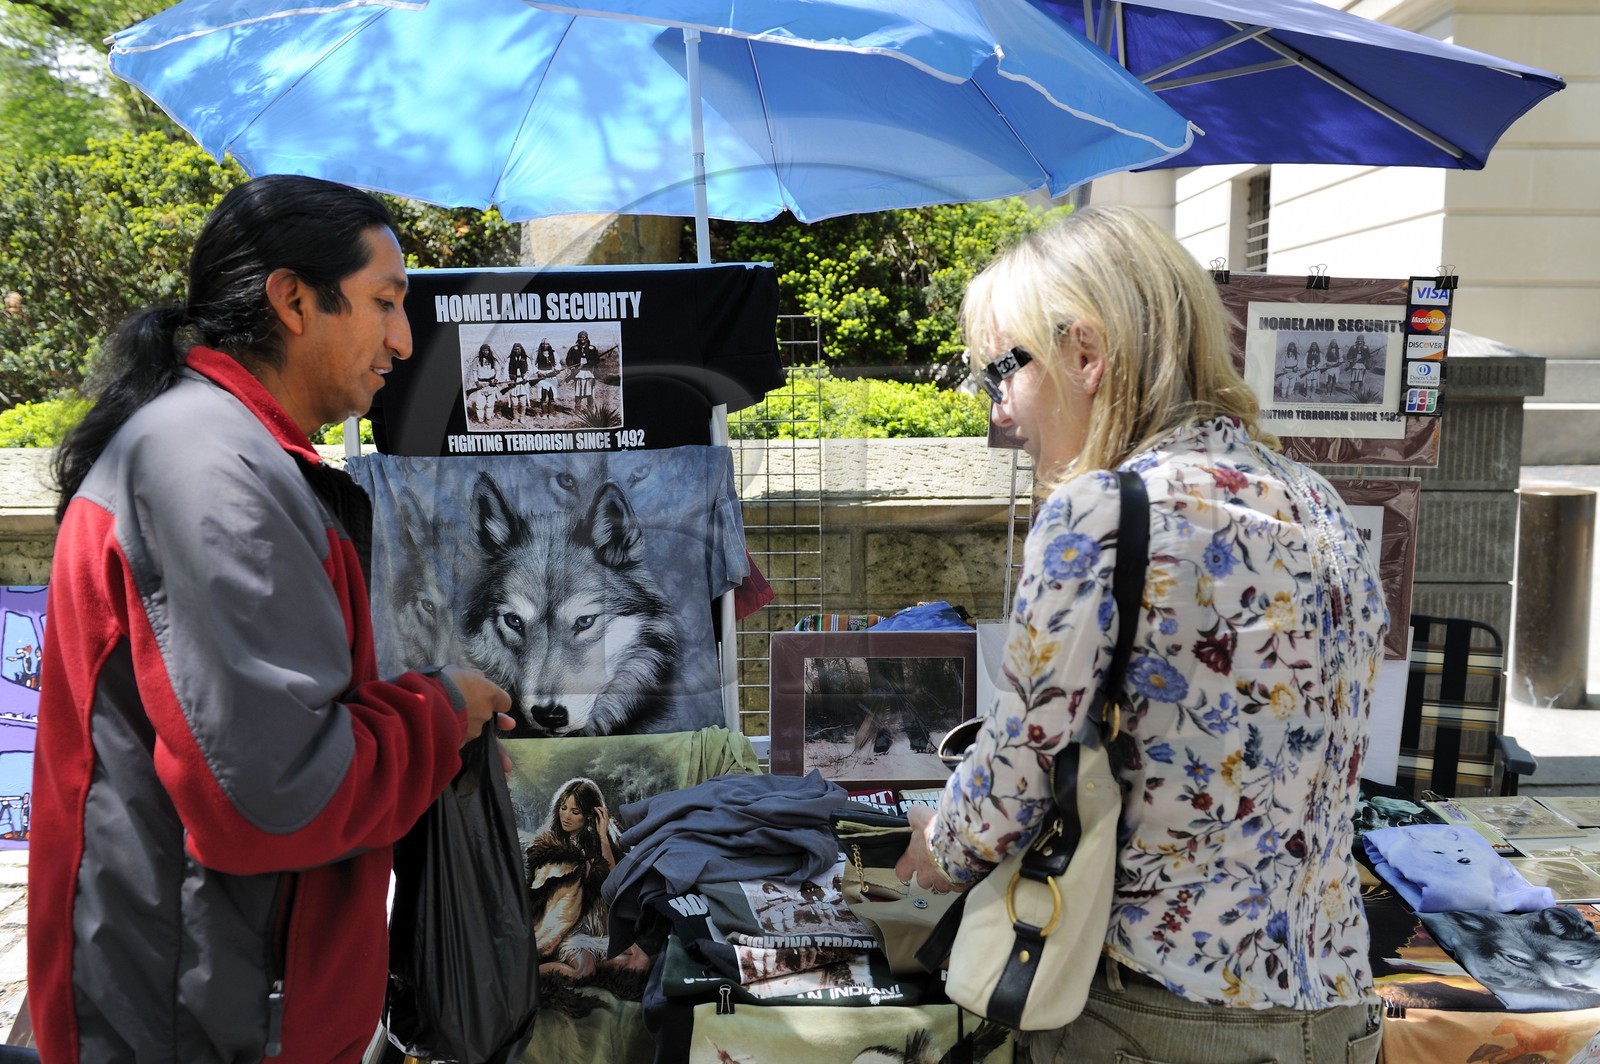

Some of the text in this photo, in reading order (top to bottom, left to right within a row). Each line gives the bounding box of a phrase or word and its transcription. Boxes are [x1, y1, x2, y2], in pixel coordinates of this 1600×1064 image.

[1416, 287, 1449, 299] VISA
[434, 291, 642, 322] HOMELAND SECURITY
[1259, 316, 1334, 331] HOMELAND
[1411, 316, 1446, 325] MasterCard
[1408, 341, 1443, 349] DISCOVER
[1408, 397, 1434, 405] JCB
[1295, 410, 1349, 421] TERRORISM
[1350, 411, 1378, 421] SINCE
[448, 429, 645, 453] FIGHTING TERRORISM SINCE 1492
[830, 984, 900, 1000] INDIAN!
